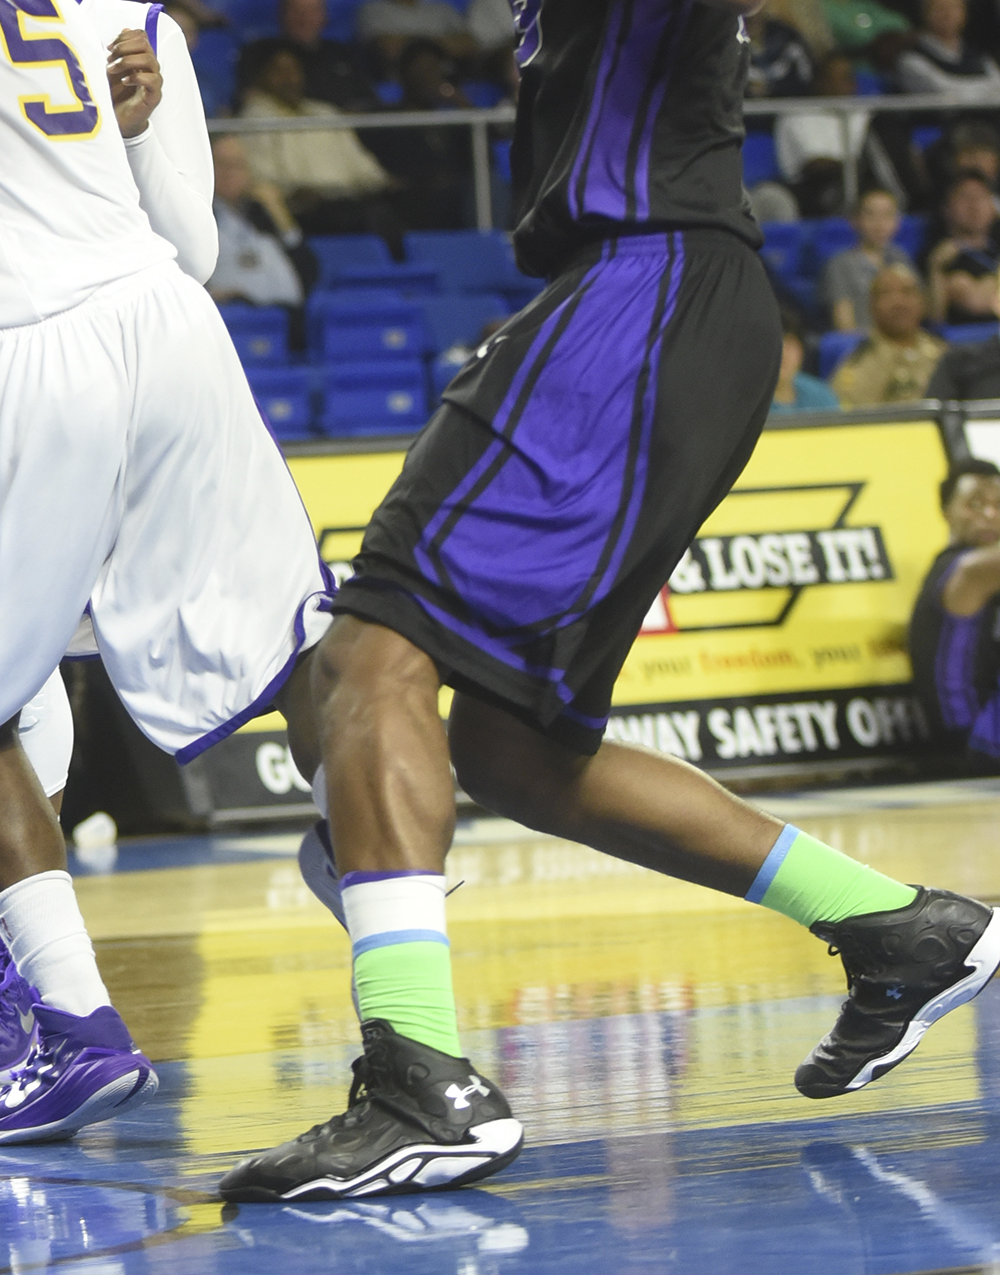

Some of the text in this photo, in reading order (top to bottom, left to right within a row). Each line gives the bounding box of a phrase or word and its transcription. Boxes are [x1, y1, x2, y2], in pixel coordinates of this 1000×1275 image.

[703, 533, 820, 591] LOSE
[818, 527, 884, 583] IT!
[707, 699, 838, 760] SAFETY
